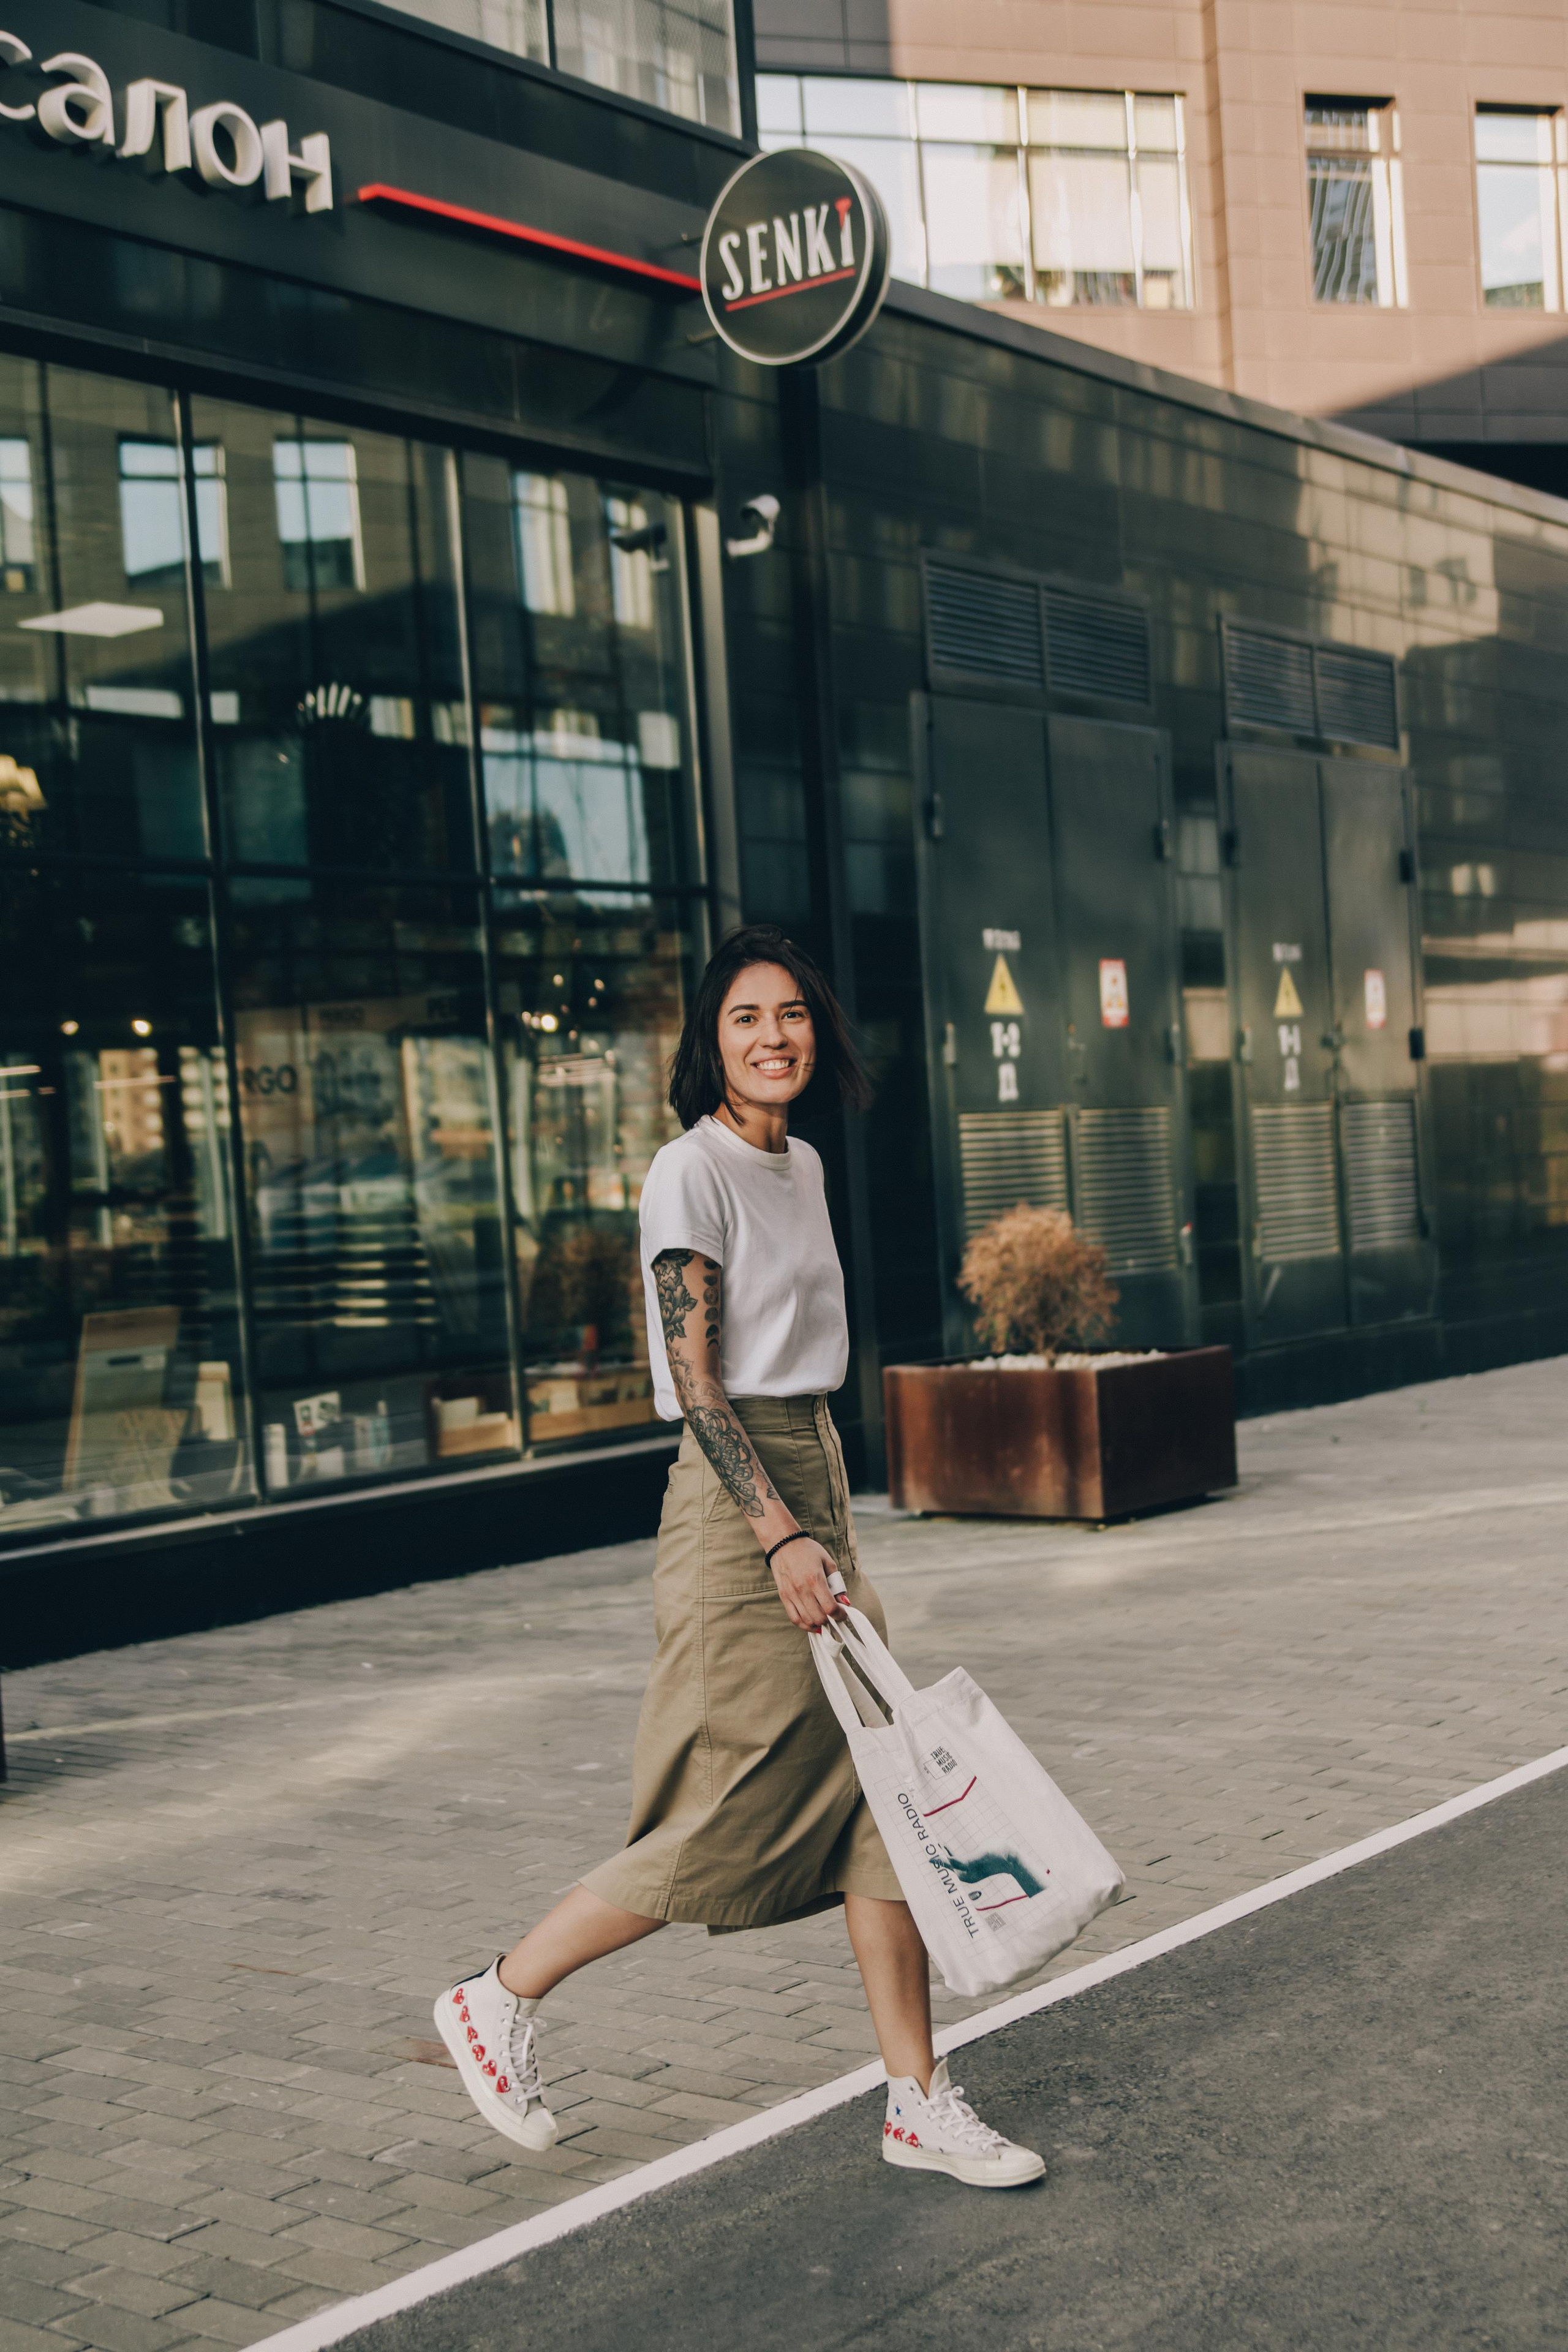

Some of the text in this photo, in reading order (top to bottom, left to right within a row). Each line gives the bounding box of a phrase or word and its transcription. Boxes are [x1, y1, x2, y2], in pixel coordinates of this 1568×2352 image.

[718, 197, 855, 301] SENKI
[930, 1746, 946, 1760] TRUE
[936, 1752, 952, 1767] MUSIC
[941, 1758, 958, 1774] RADIO
[897, 1793, 979, 1939] TRUE MUSIC RADIO
